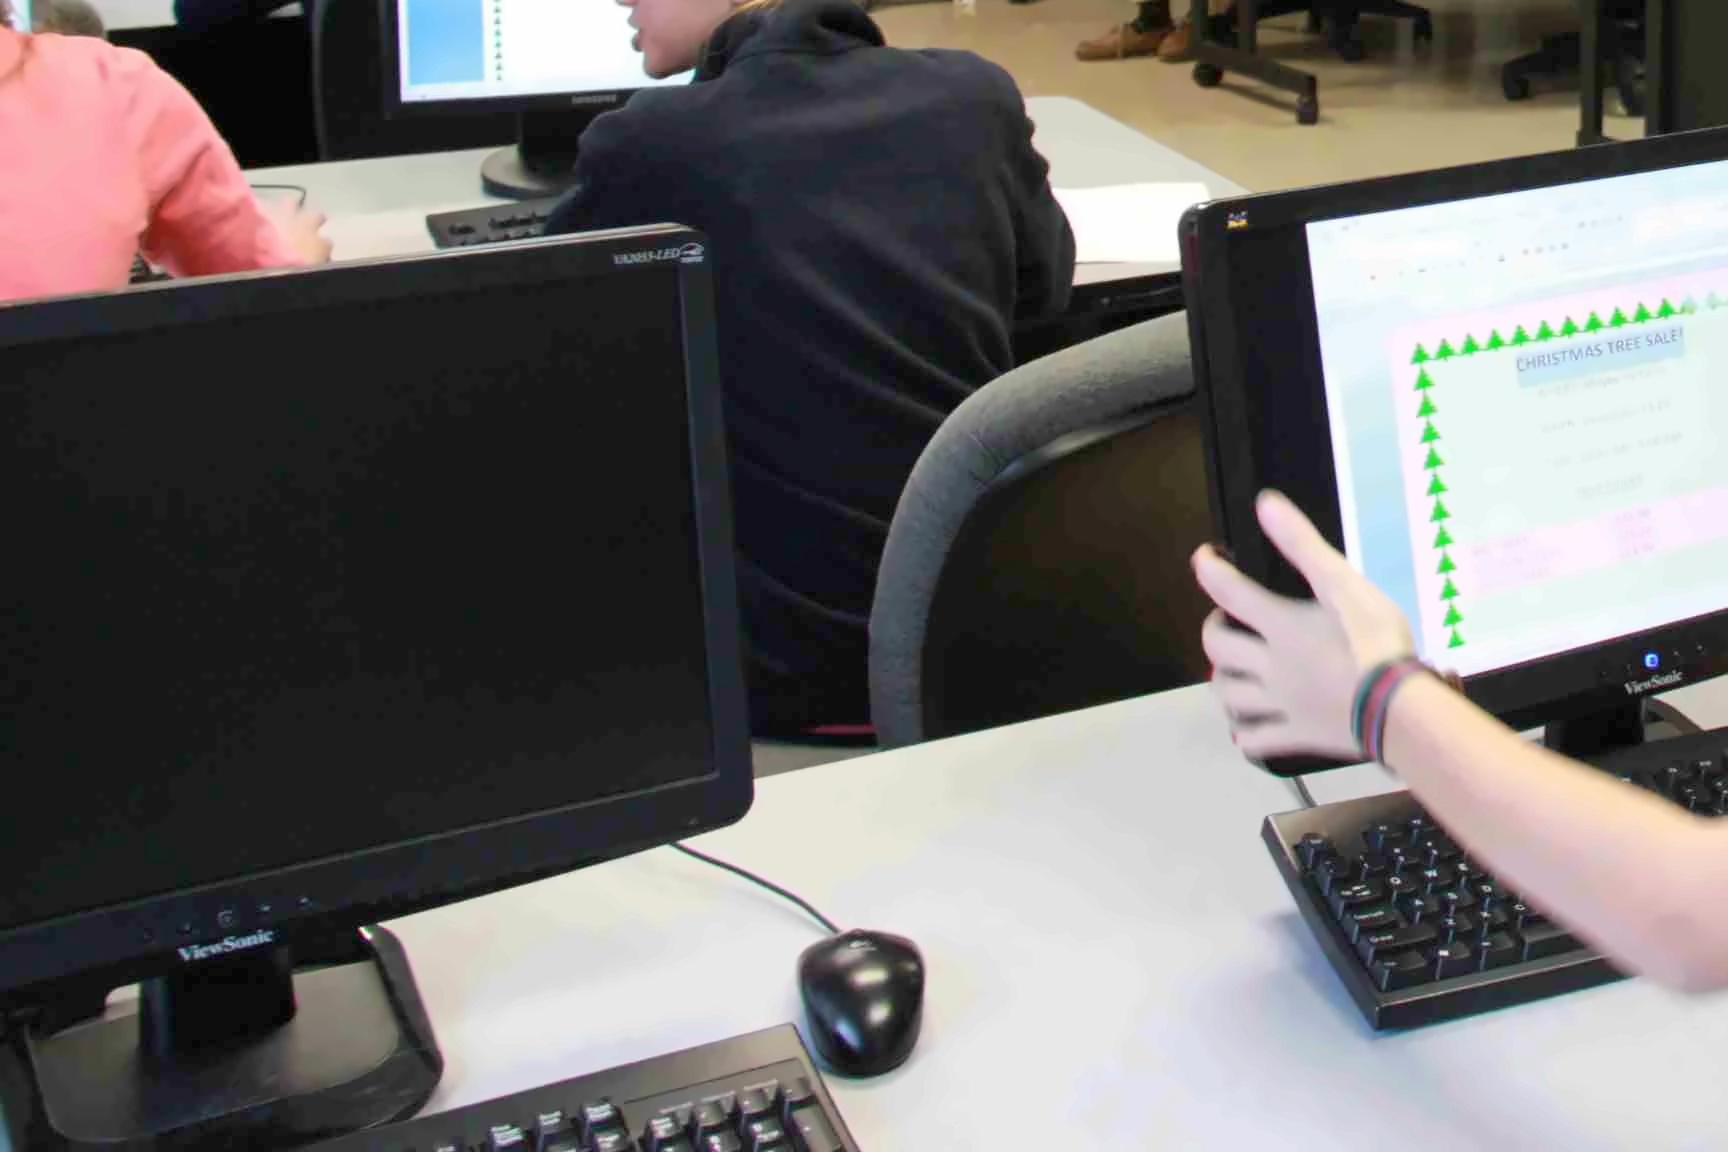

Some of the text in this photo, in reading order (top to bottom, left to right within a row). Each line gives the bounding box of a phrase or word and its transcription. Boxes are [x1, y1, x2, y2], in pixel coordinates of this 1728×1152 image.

[1516, 326, 1684, 372] CHRISTMAS TREE SALE!
[1624, 669, 1684, 695] ViewSonic
[177, 929, 273, 961] ViewSonic
